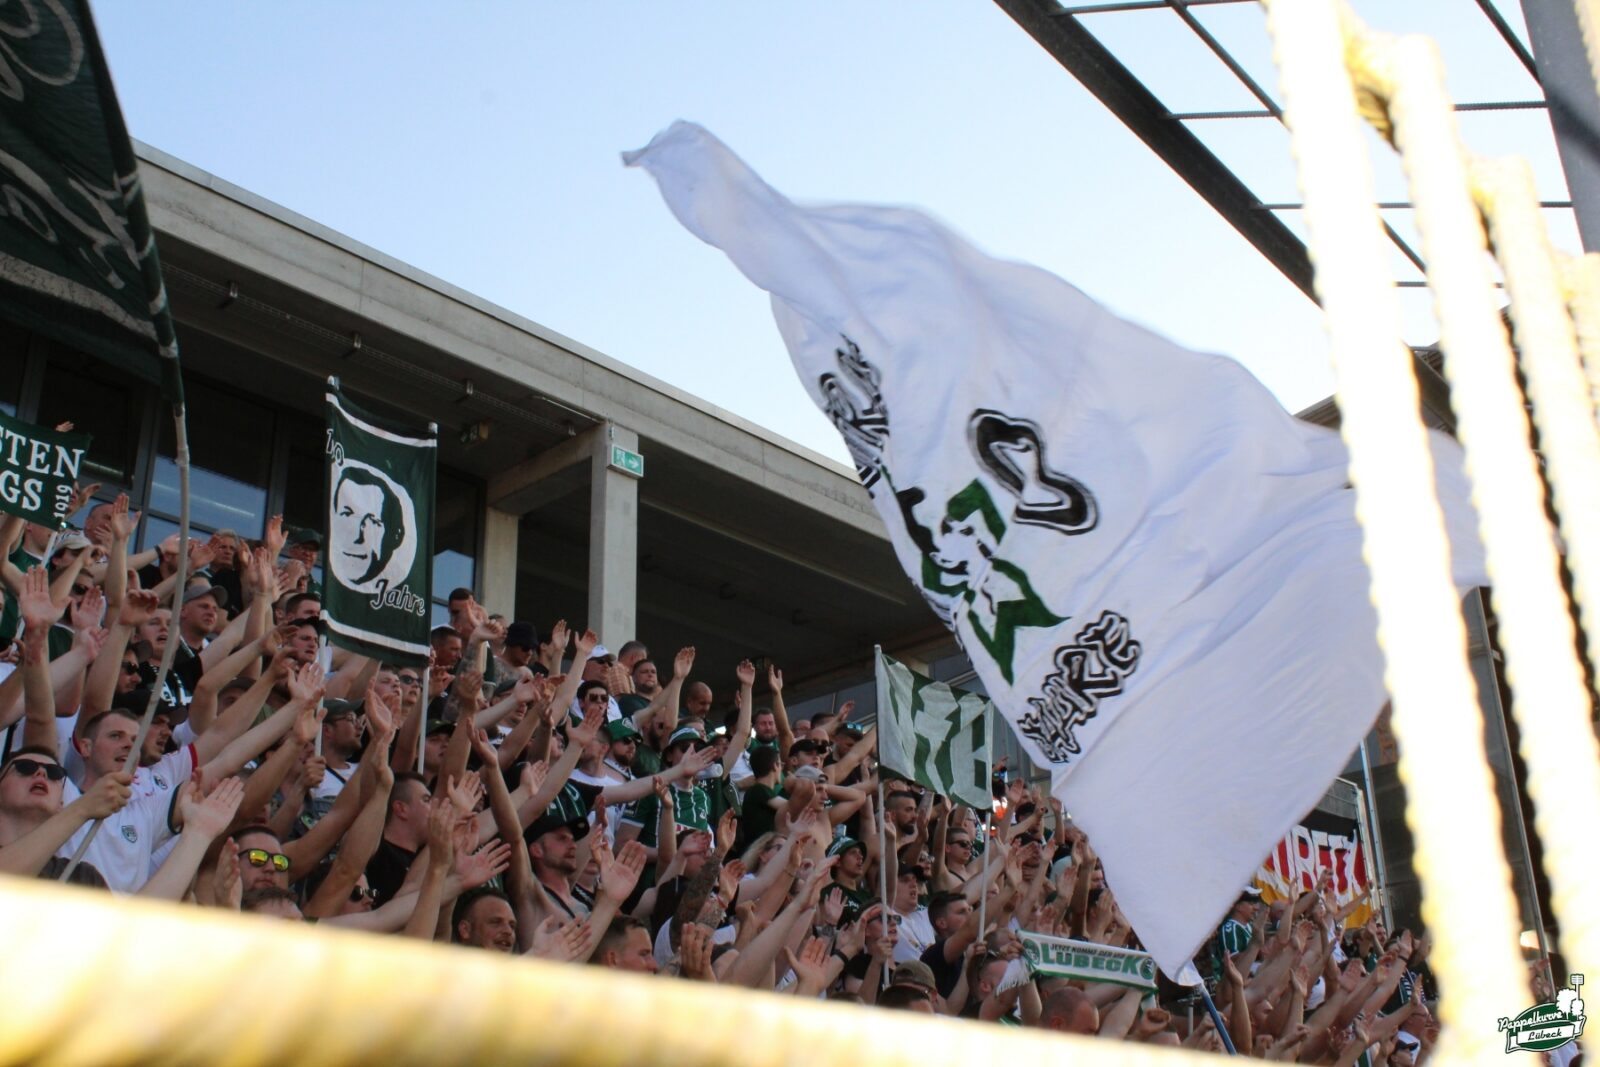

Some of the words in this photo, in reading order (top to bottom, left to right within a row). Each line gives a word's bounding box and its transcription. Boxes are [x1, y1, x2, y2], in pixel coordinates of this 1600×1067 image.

[0, 426, 85, 480] TEN
[54, 484, 73, 519] 1919
[370, 578, 426, 616] Jahre
